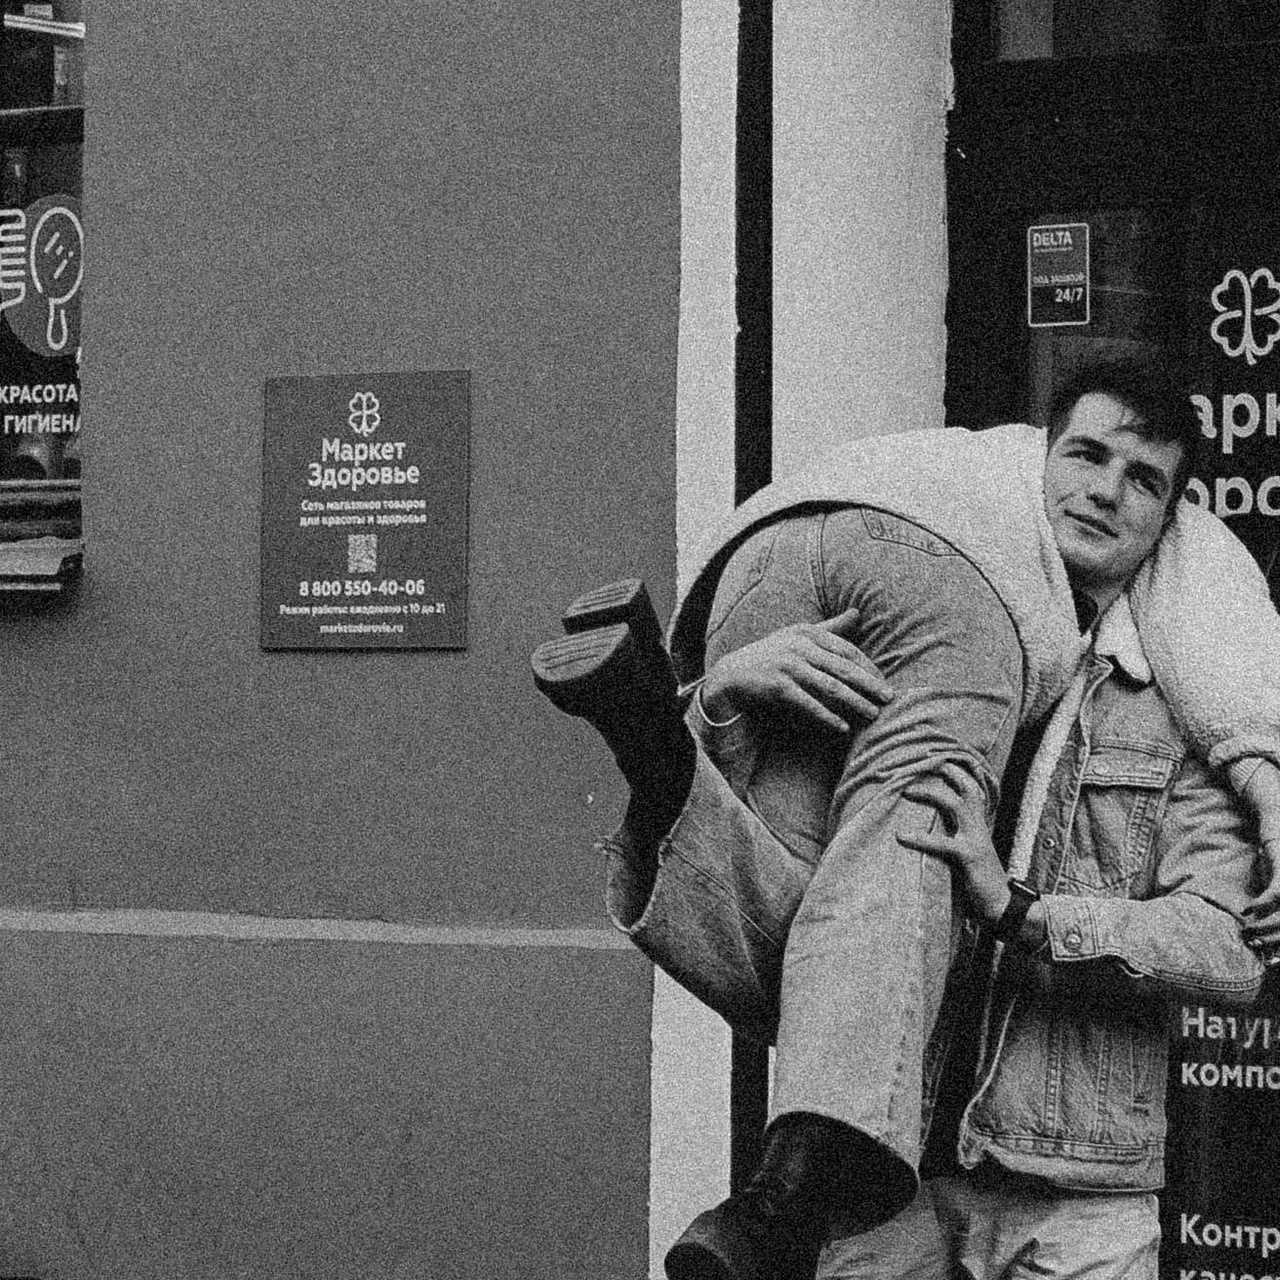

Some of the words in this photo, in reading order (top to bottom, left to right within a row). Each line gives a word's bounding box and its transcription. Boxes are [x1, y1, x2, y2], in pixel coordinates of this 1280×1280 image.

[1033, 231, 1073, 247] DELTA
[1054, 287, 1084, 304] 24/7
[321, 437, 407, 467] Маркет
[307, 462, 421, 492] Здоровье
[299, 581, 309, 597] 8
[312, 580, 342, 597] 800
[344, 578, 425, 597] 550-40-06
